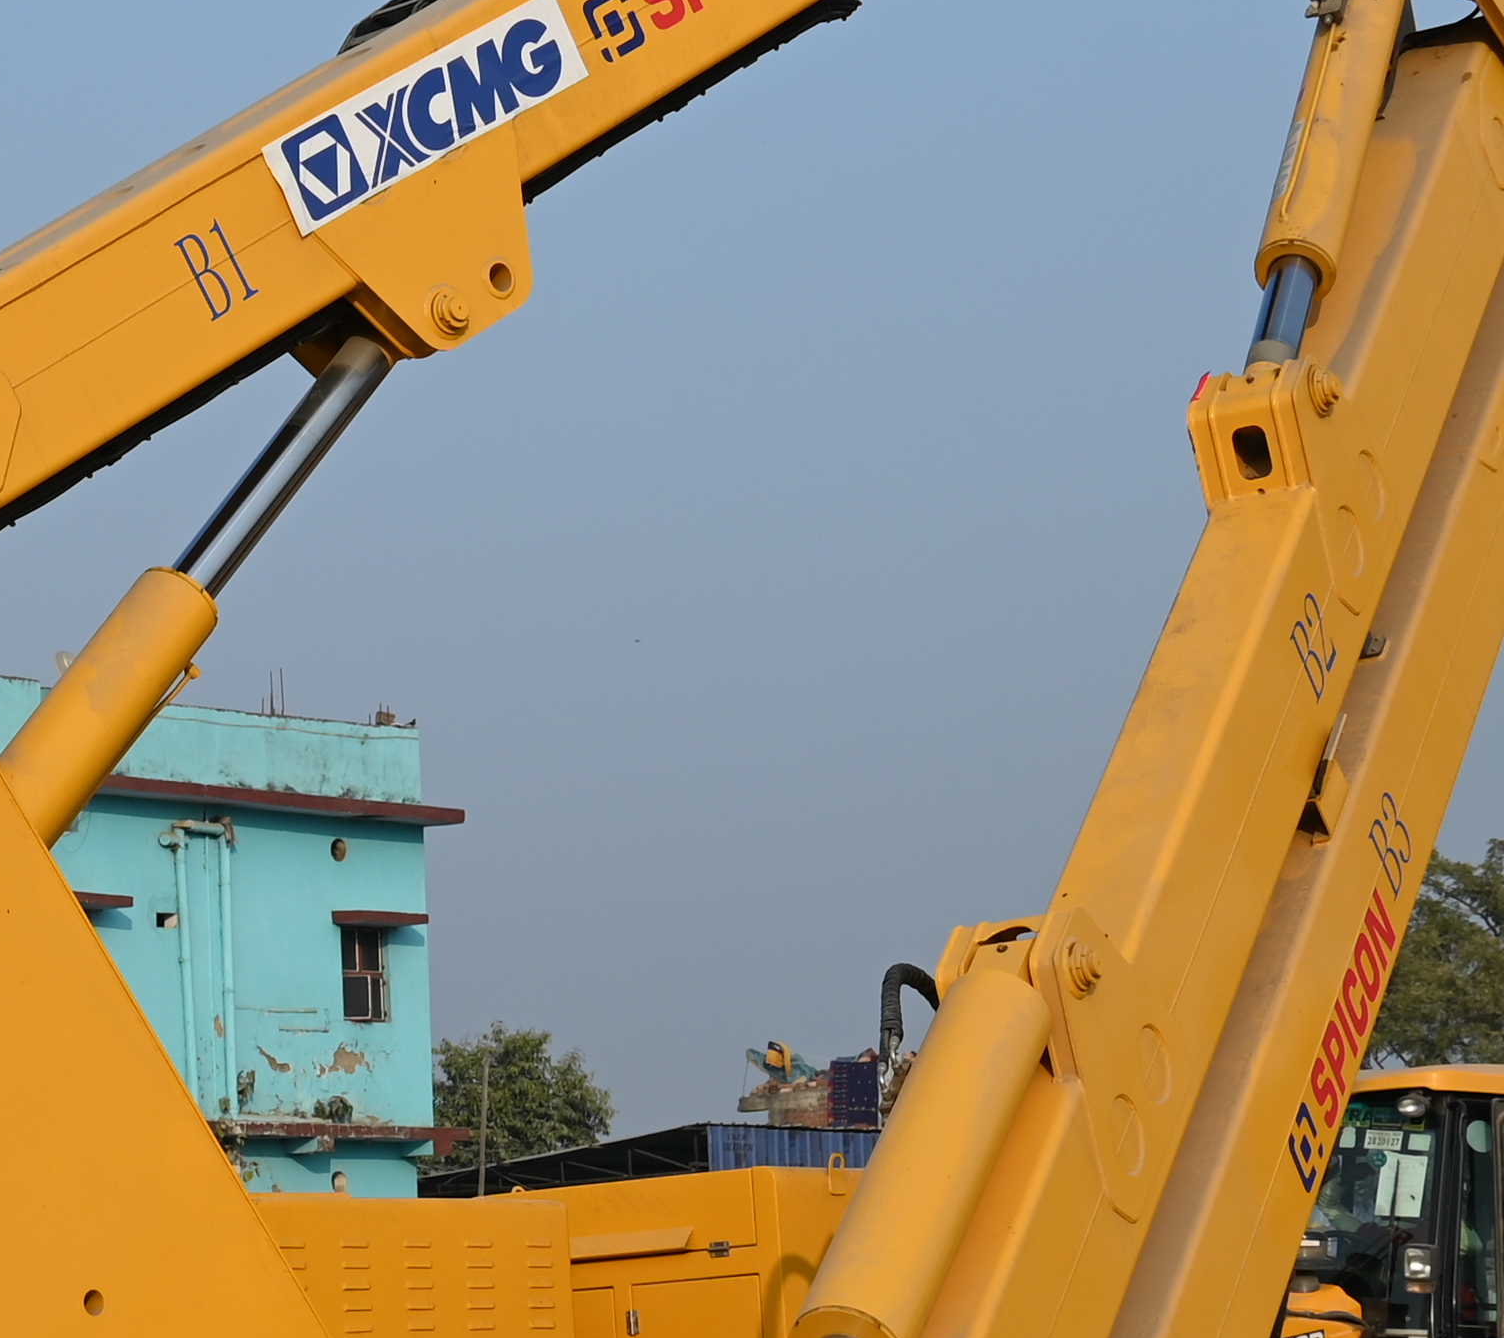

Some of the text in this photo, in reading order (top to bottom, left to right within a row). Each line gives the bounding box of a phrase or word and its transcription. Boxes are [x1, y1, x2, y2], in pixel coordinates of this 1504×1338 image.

[355, 18, 563, 191] XCMG
[173, 217, 260, 322] B1
[1289, 592, 1338, 705] B2
[1368, 791, 1413, 902] B3
[1311, 888, 1398, 1129] SPICON
